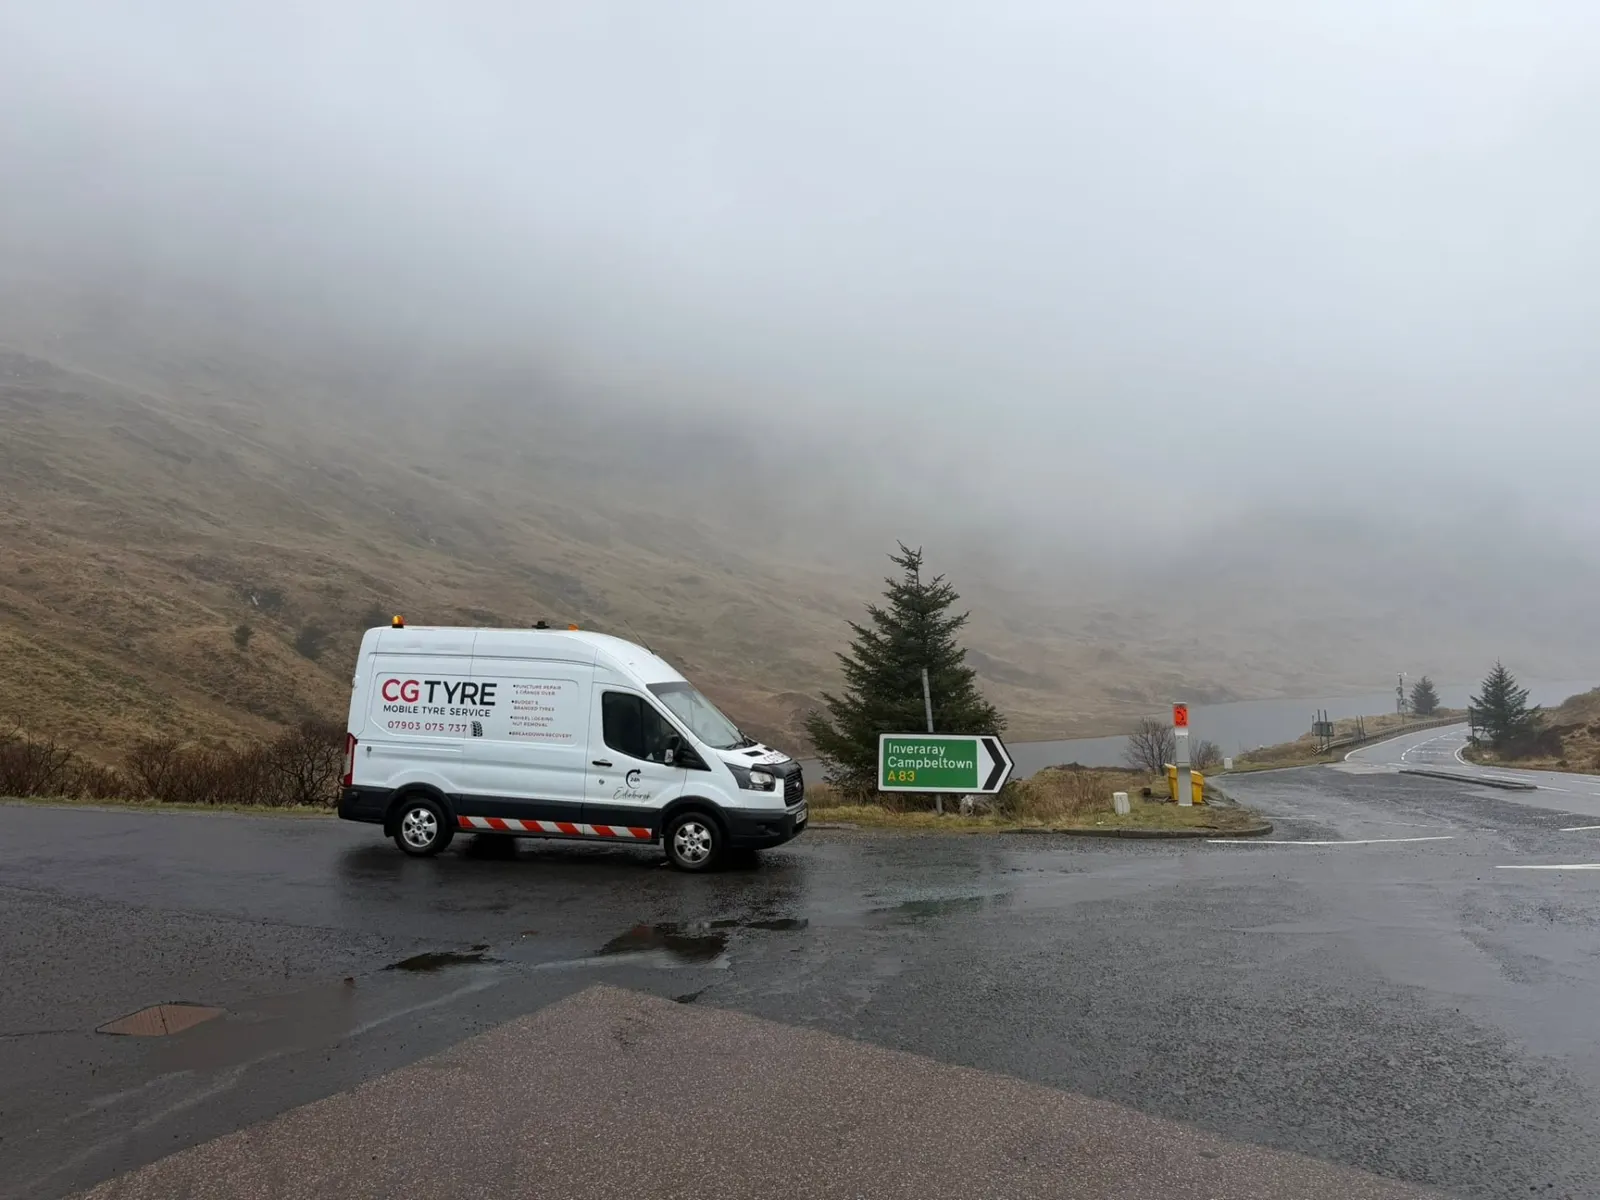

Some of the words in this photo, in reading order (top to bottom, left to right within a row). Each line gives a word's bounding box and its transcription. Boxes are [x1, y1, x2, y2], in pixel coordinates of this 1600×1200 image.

[383, 705, 418, 714] MOBILE
[422, 706, 445, 715] TYRE
[449, 707, 491, 717] SERVICE
[388, 721, 420, 730] 07903
[425, 722, 444, 731] 075
[448, 724, 467, 732] 737
[888, 743, 945, 756] Inveraray
[887, 757, 973, 770] Campbeltown
